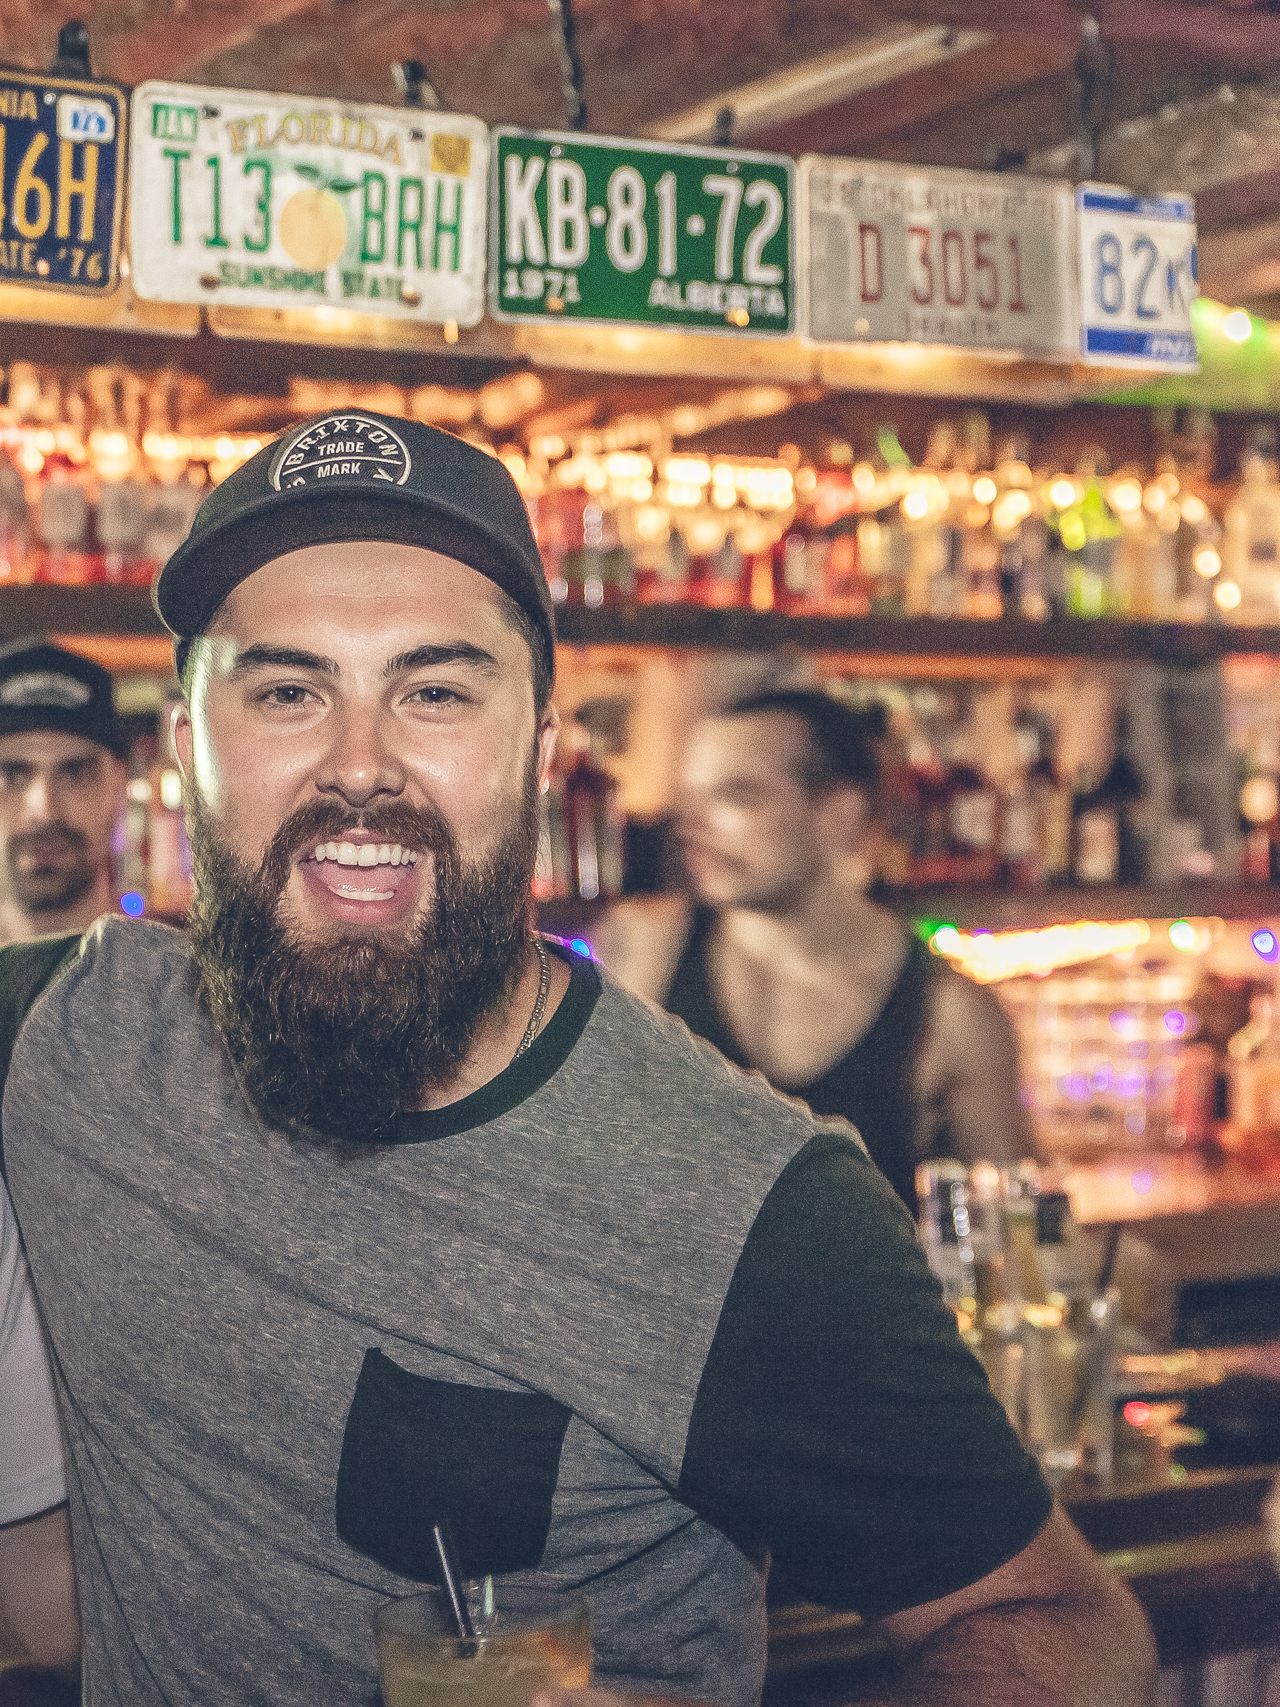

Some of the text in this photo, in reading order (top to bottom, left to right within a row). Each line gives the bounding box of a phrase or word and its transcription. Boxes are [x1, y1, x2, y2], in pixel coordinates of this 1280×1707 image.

[226, 112, 404, 166] FLORIDA
[163, 149, 465, 272] T13 BRH
[503, 267, 582, 304] 1971
[908, 226, 1029, 314] 3051
[648, 278, 787, 318] ALBERTA
[285, 419, 400, 467] BRIXTON
[317, 441, 366, 457] TRADE
[317, 461, 362, 478] MARK
